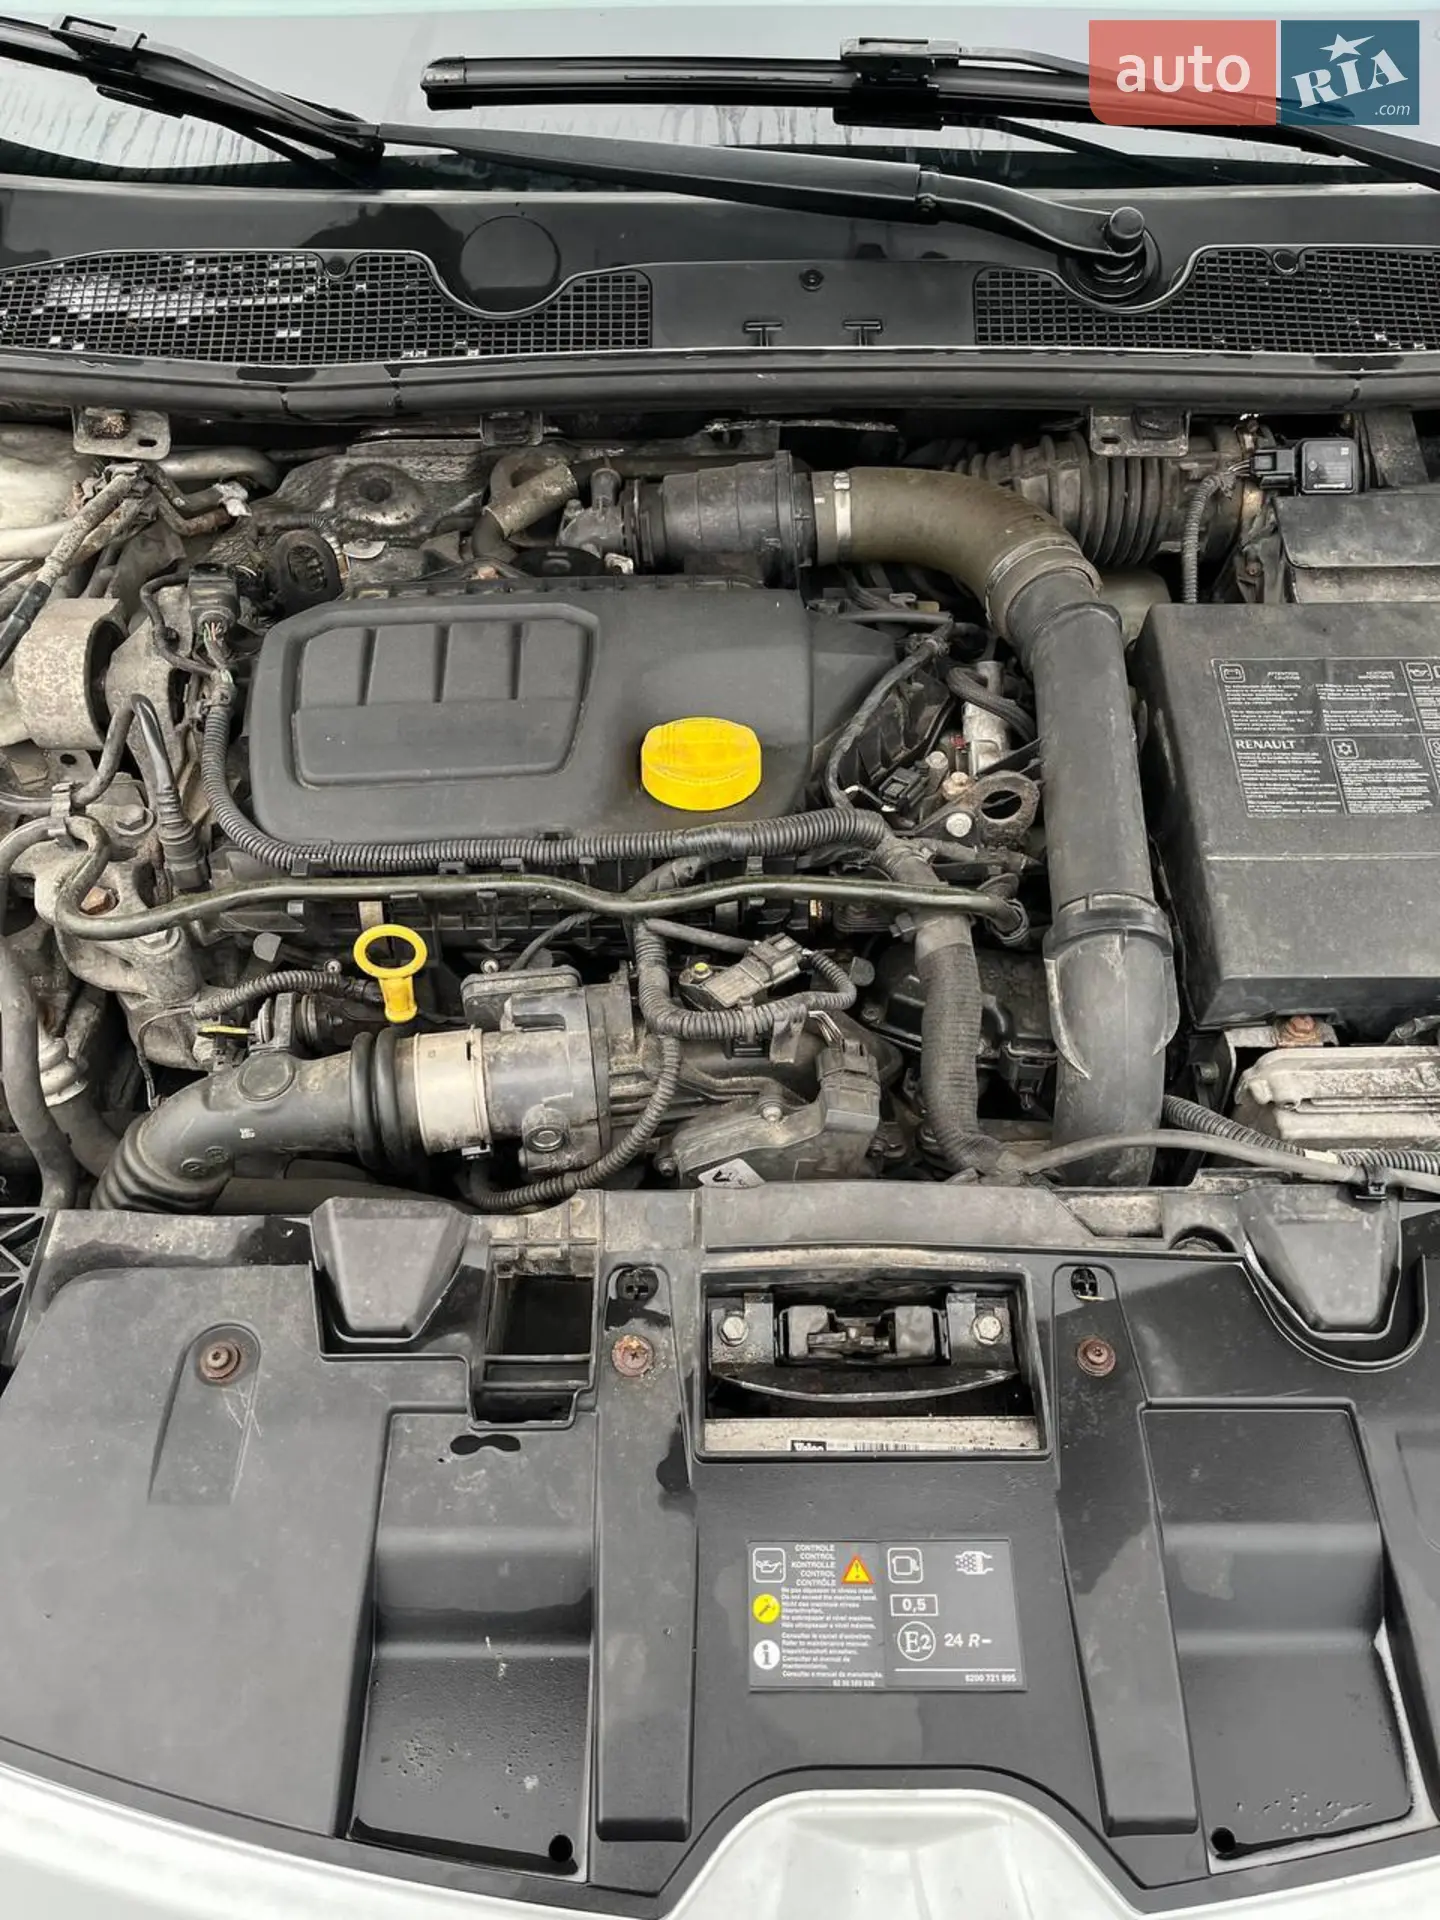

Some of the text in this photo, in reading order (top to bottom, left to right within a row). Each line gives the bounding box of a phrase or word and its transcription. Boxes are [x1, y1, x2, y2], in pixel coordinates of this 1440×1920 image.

[1235, 739, 1297, 749] RENAULT
[800, 1552, 835, 1560] CONTROL
[902, 1598, 926, 1612] 0,5
[904, 1631, 932, 1652] E2
[944, 1633, 963, 1648] 24
